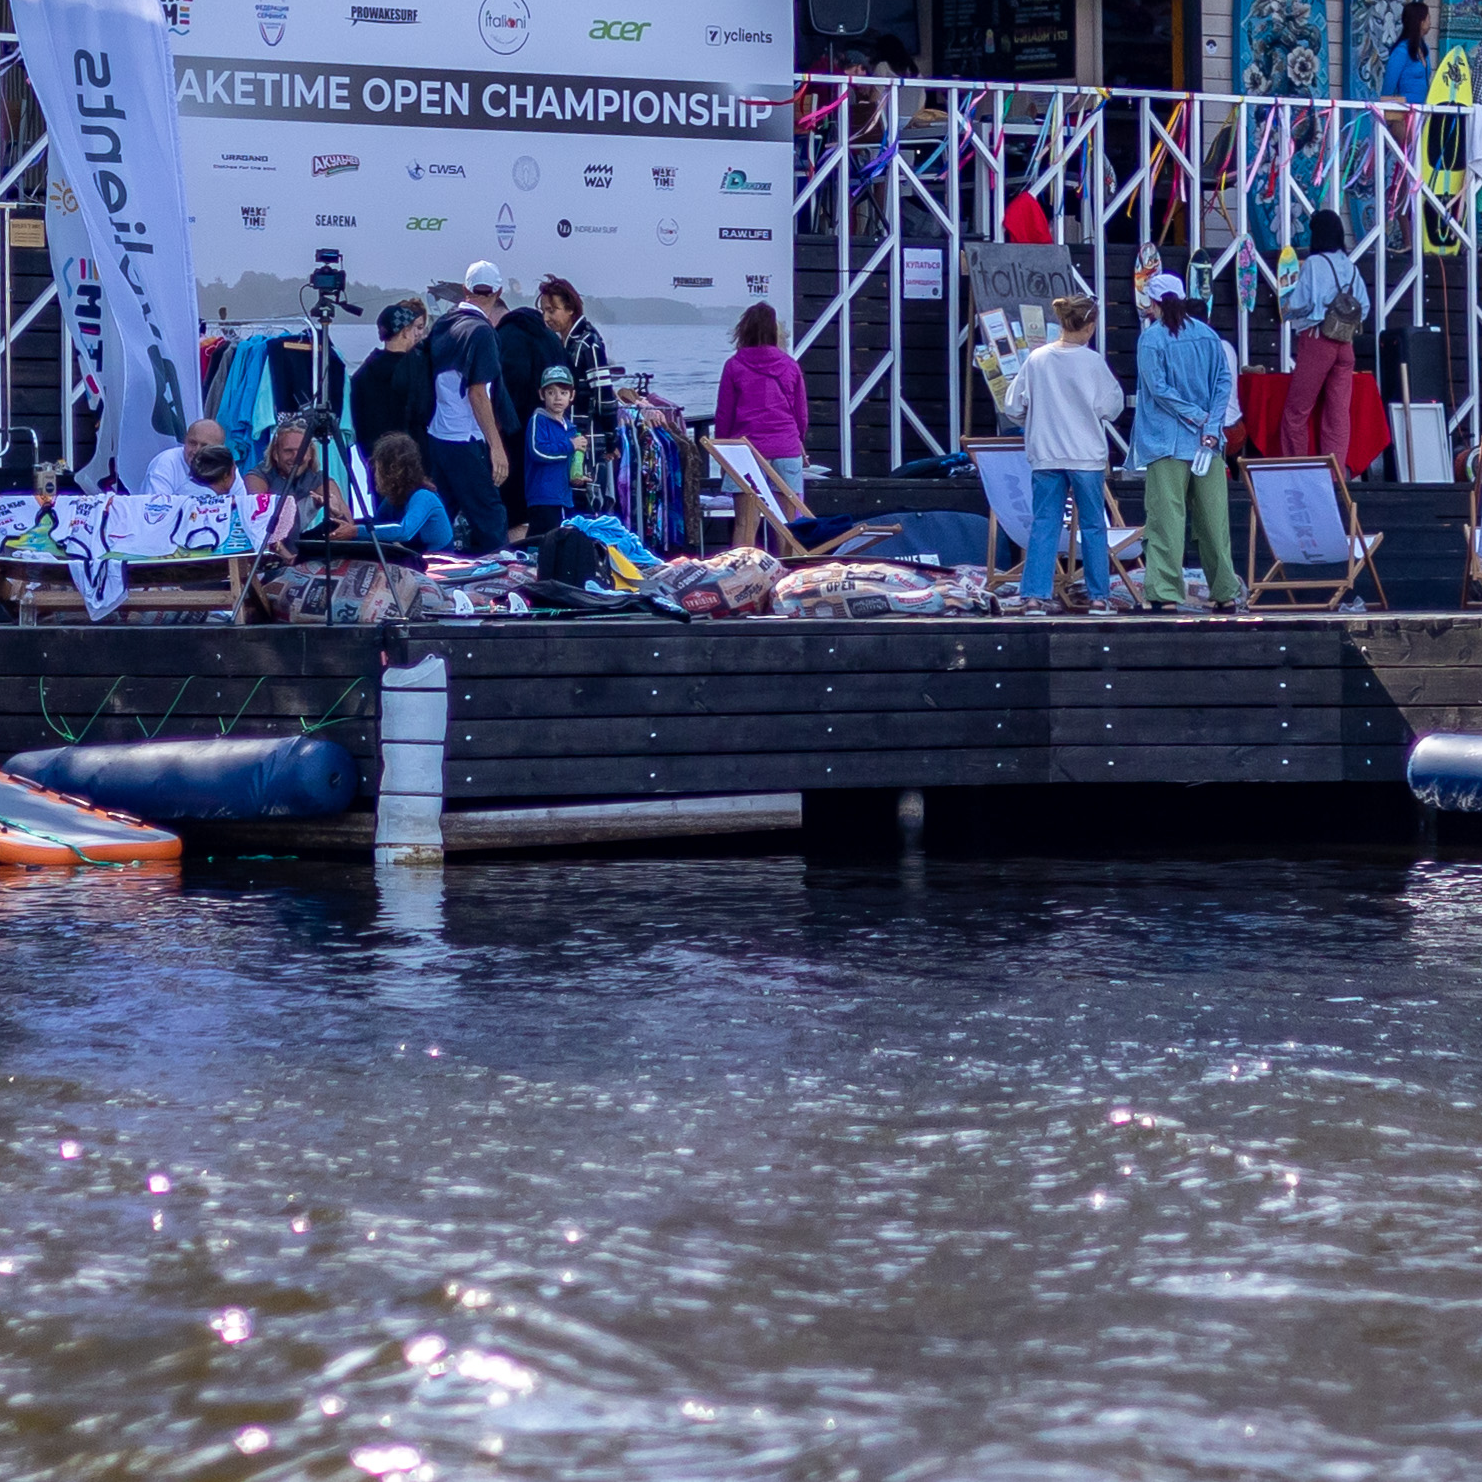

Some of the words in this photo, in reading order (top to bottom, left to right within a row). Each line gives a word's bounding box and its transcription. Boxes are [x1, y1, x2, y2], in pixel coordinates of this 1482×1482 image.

[255, 4, 290, 12] ФЕДЕРАЦИЯ
[350, 5, 419, 22] PROWAKESURF
[588, 19, 652, 42] acer
[723, 27, 773, 45] yclients
[175, 67, 351, 111] AKETIME
[362, 77, 470, 116] OPEN
[481, 82, 773, 129] CHAMPIONSHIP
[428, 164, 467, 179] CWSA
[584, 176, 613, 189] WAY
[315, 214, 357, 228] SEARENA
[406, 216, 448, 232] acer
[825, 580, 857, 593] OPEN
